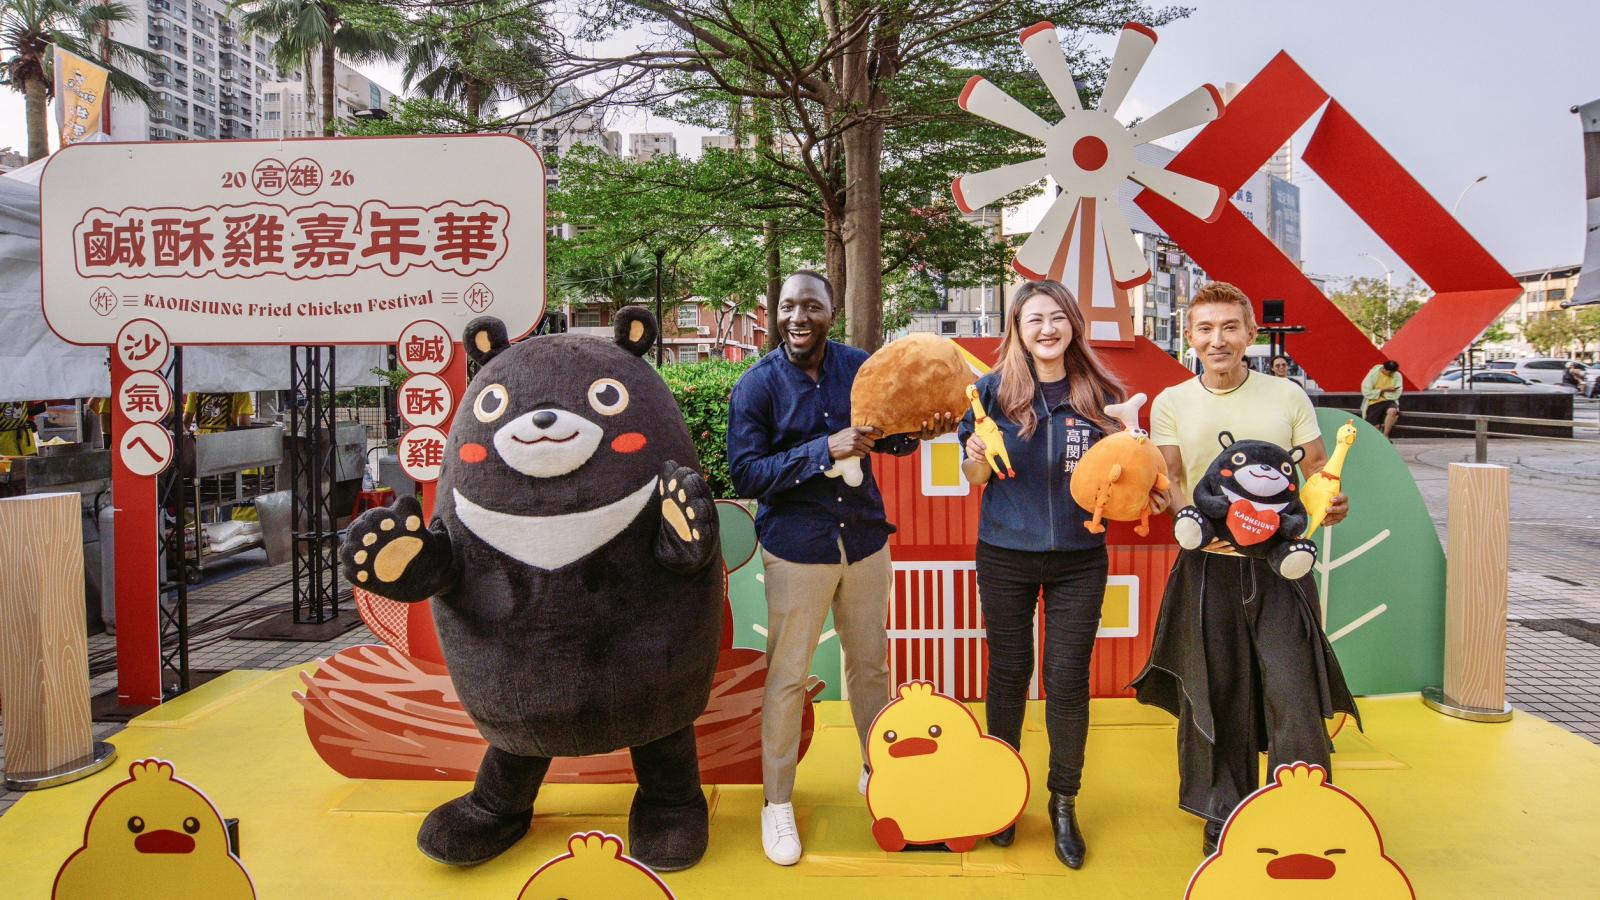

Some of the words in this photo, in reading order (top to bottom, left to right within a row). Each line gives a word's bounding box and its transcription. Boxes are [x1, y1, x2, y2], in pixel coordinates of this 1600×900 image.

[221, 171, 247, 188] 20
[255, 164, 319, 189] 高雄
[330, 168, 355, 187] 26
[1232, 189, 1253, 202] 廣告
[84, 211, 499, 270] 鹹酥雞嘉年華
[94, 292, 113, 312] 炸
[143, 293, 243, 316] KAOHSIUNG
[248, 303, 292, 317] Fried
[296, 301, 362, 317] Chicken
[368, 290, 434, 312] Festival
[468, 288, 490, 308] 炸
[405, 335, 445, 468] 鹹酥雞
[1081, 429, 1090, 456] 觀光局
[1233, 510, 1275, 531] KAOHSIUNG
[1241, 522, 1262, 535] LOVE
